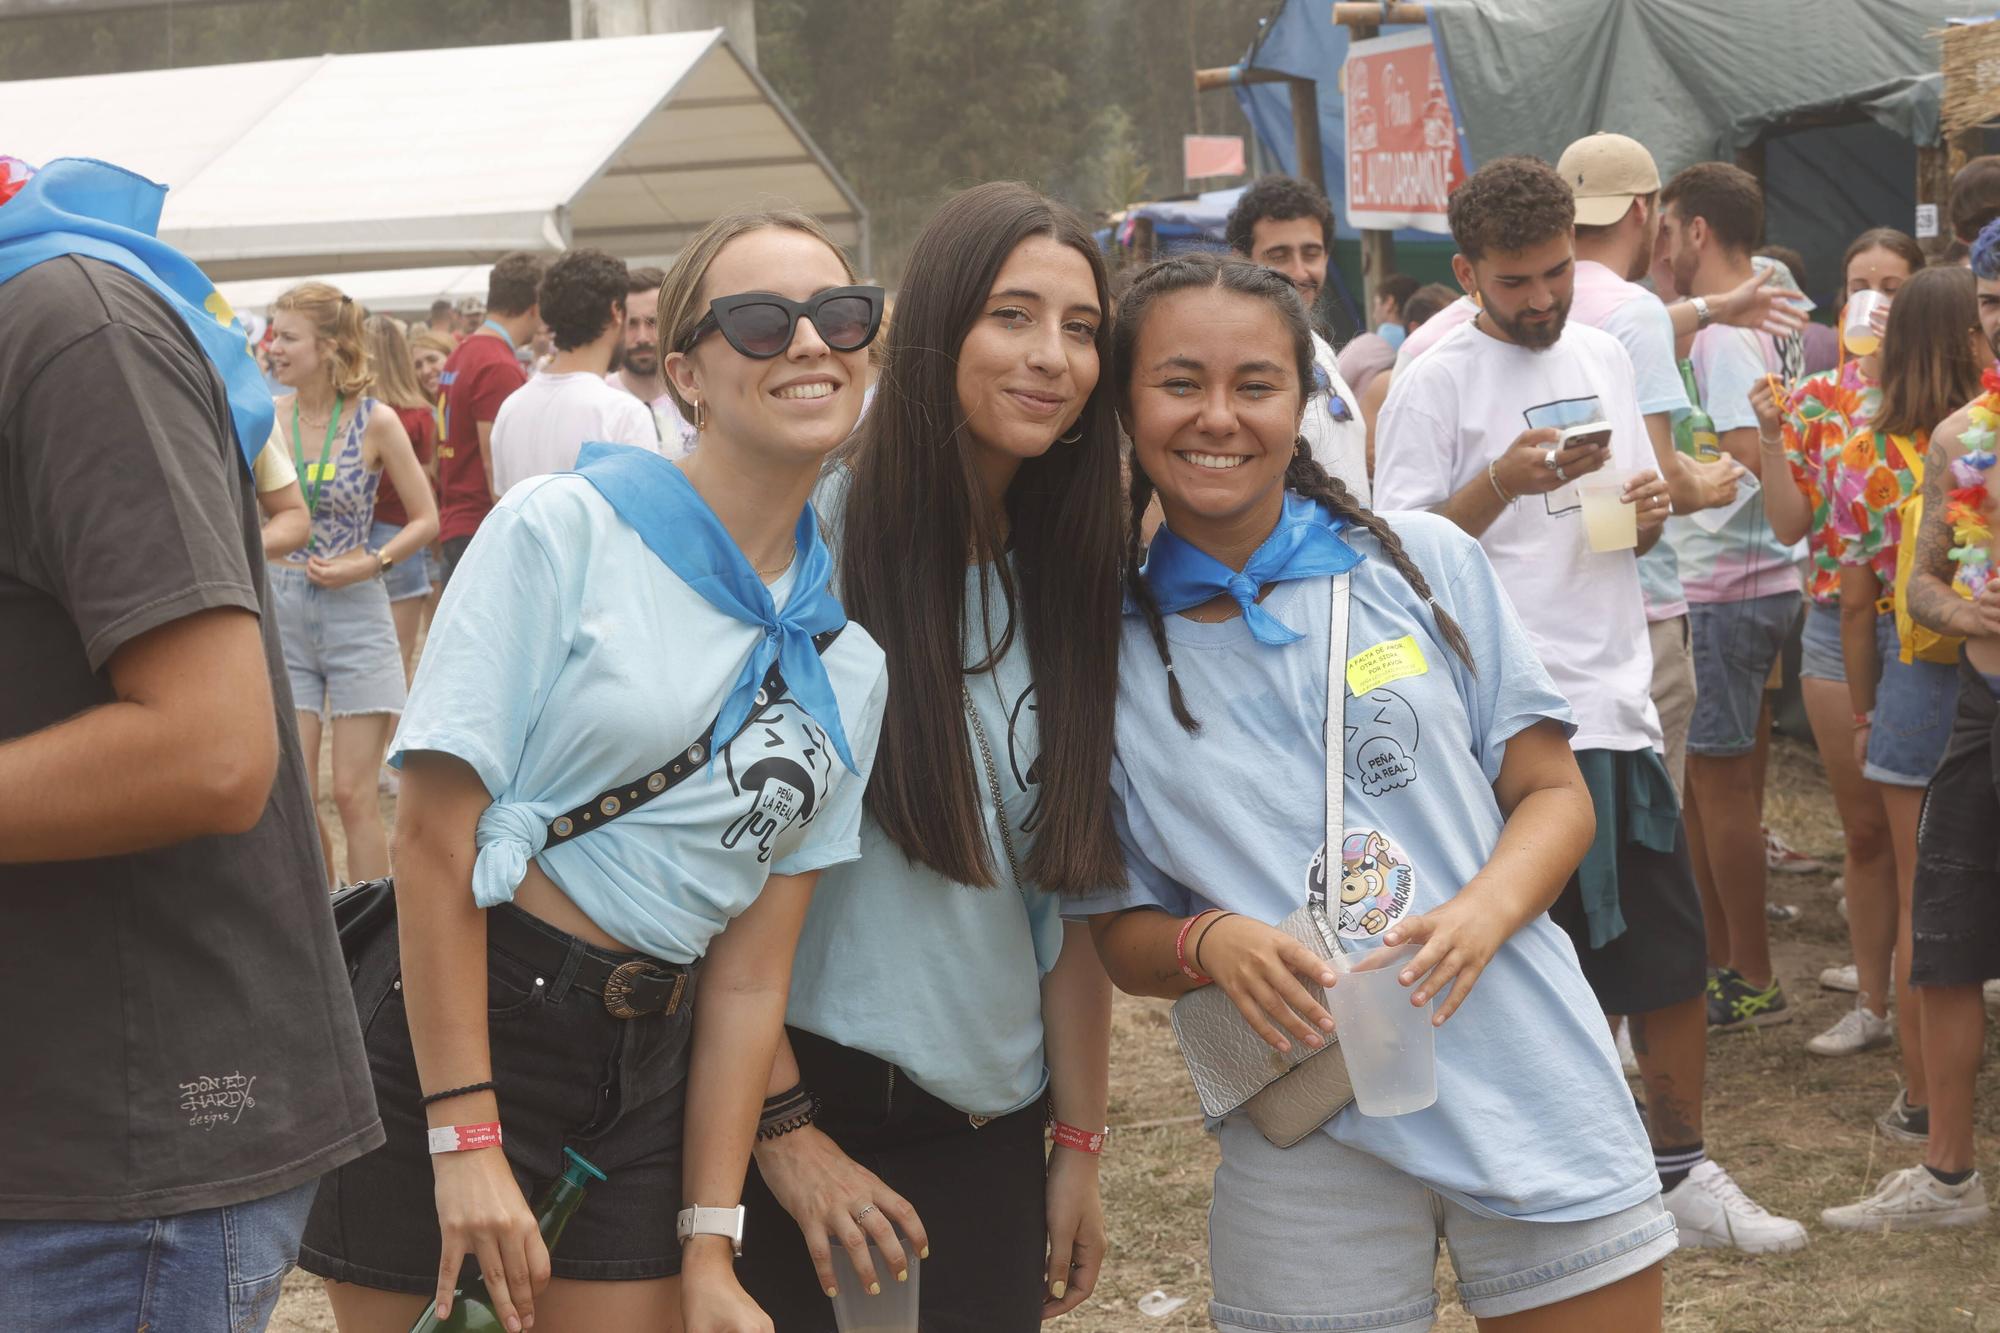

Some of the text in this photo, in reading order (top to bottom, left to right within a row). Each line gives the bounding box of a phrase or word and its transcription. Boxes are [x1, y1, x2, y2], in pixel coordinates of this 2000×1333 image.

[1354, 652, 1374, 665] FALTA
[1375, 647, 1385, 655] DE
[1360, 660, 1378, 671] OTRA
[1368, 666, 1382, 675] POR
[1368, 752, 1396, 769] PEÑA
[1367, 763, 1408, 784] LA REAL
[776, 786, 794, 803] PEÑA
[762, 795, 795, 821] LA REAL
[1384, 865, 1412, 919] CHARANGA
[180, 1076, 256, 1124] HARDY
